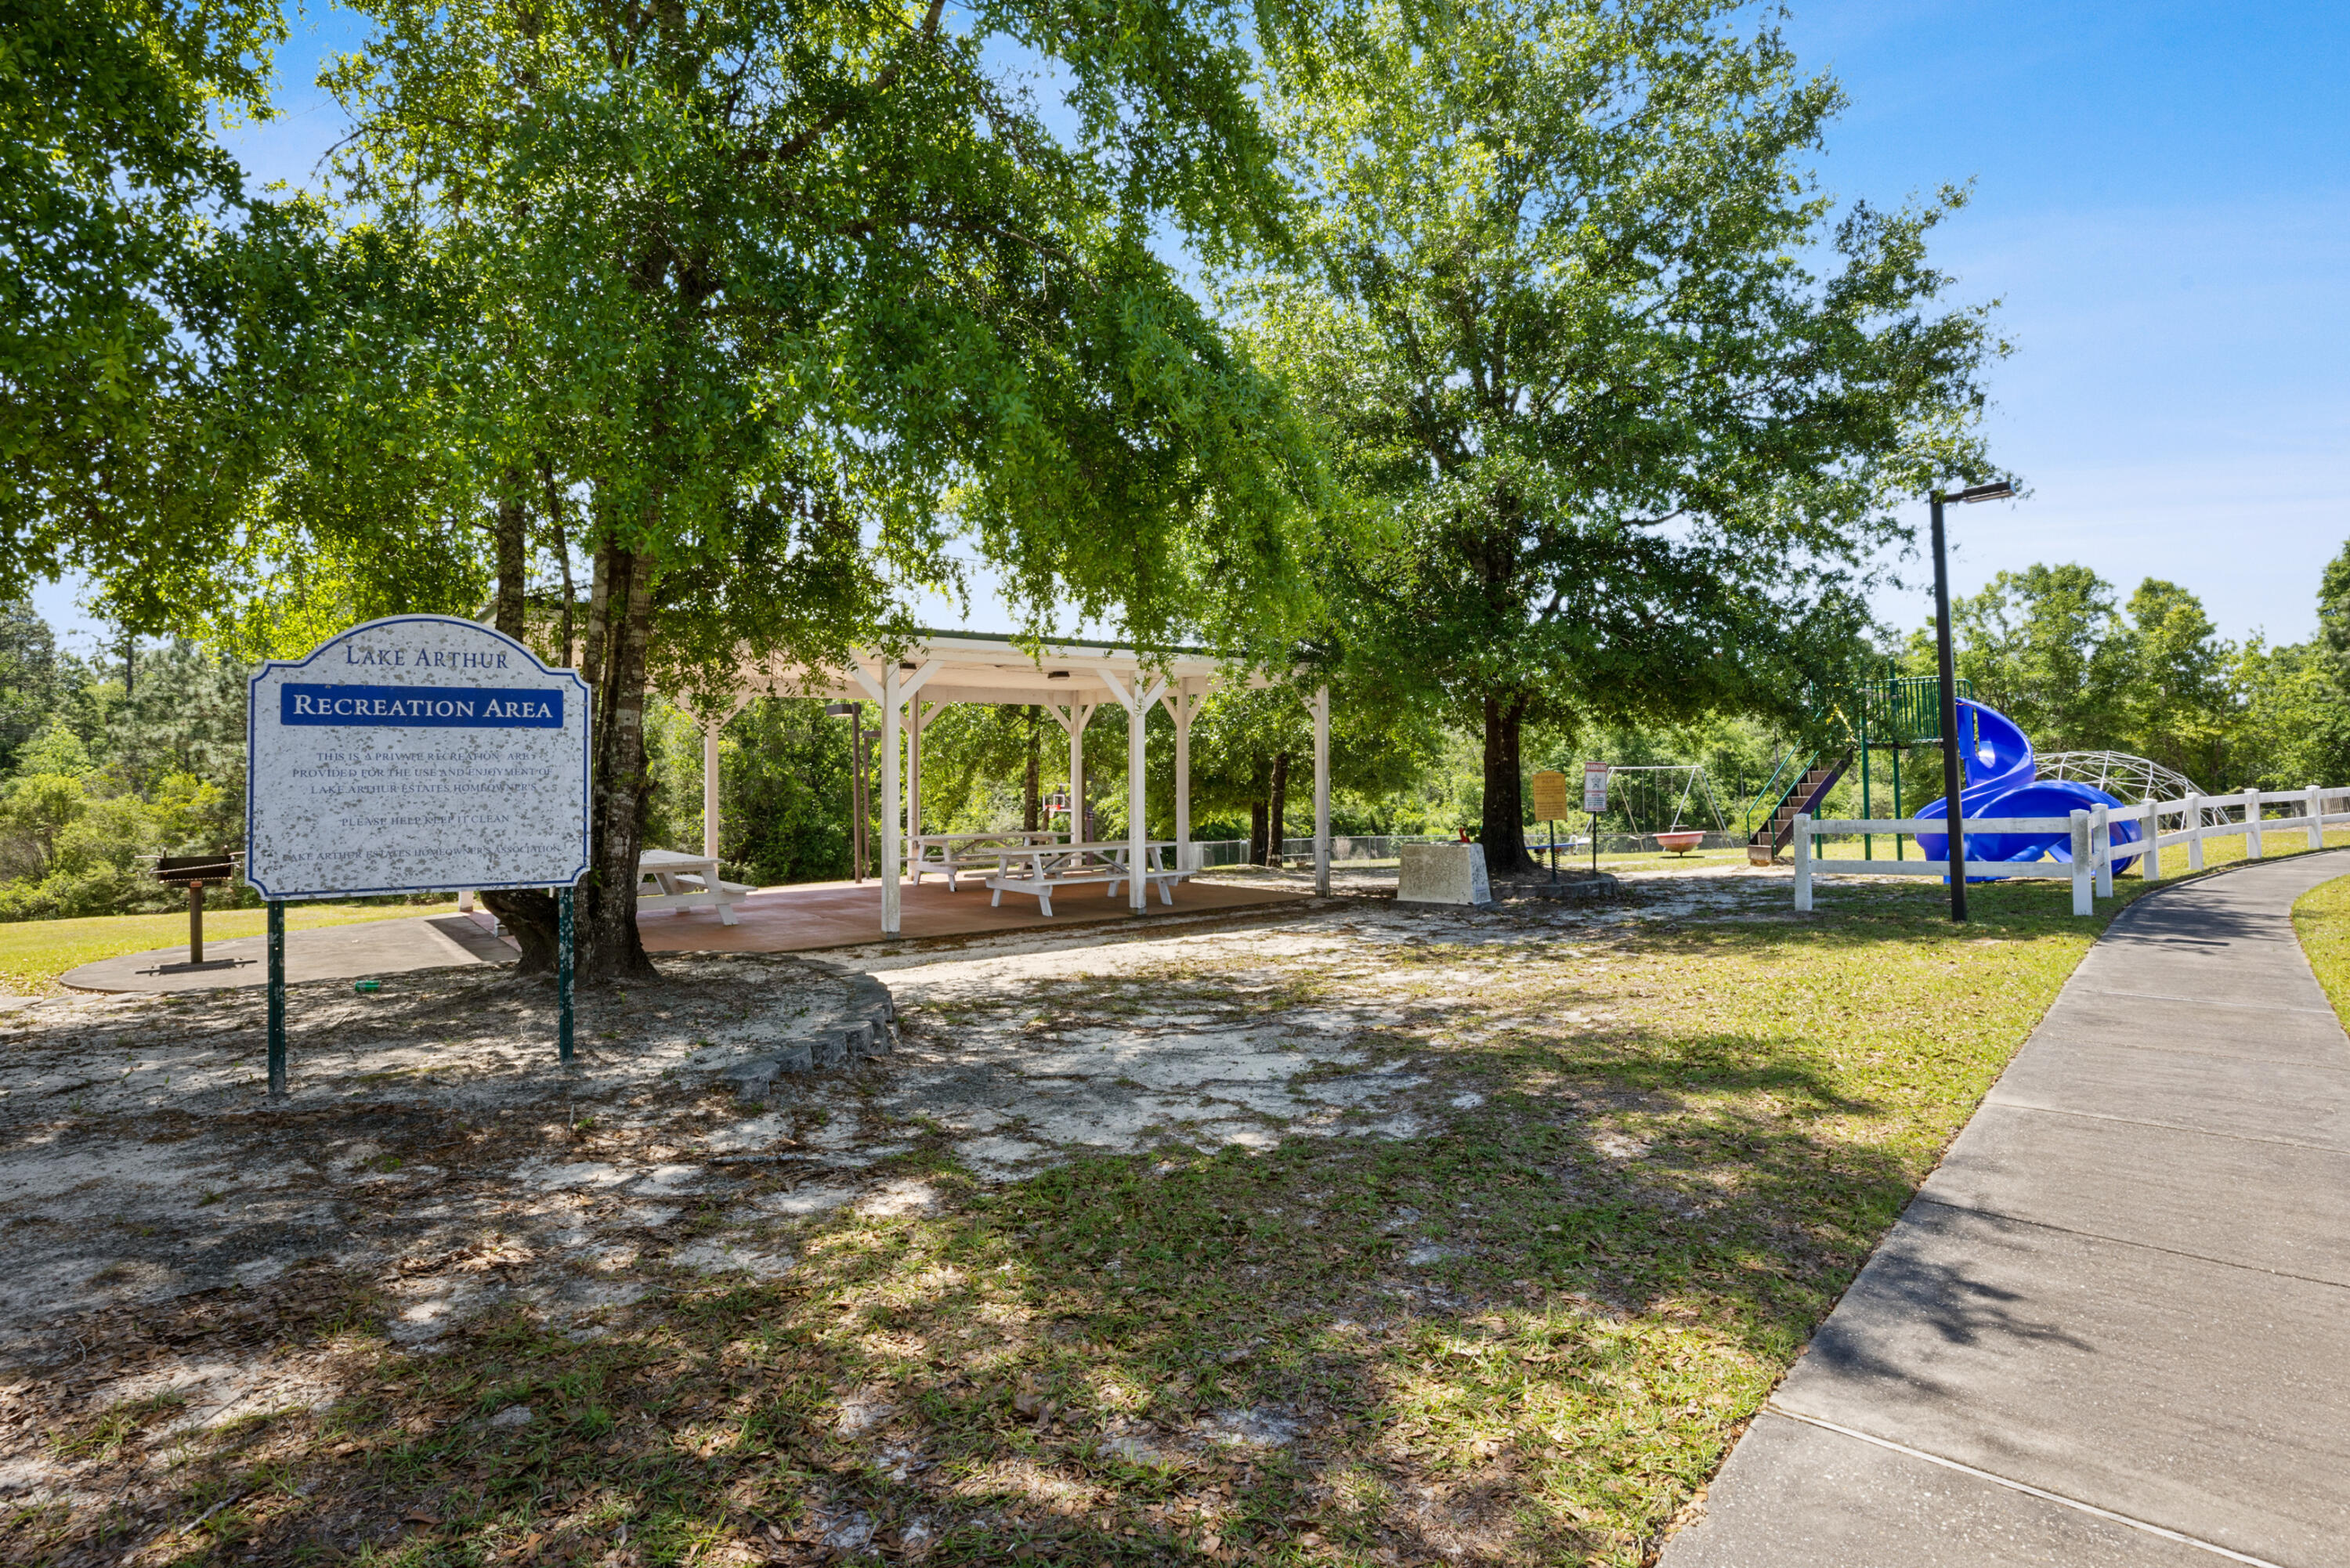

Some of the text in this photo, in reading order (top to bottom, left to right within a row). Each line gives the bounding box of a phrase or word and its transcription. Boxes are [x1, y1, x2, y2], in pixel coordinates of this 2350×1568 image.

[345, 645, 508, 669] LAKE ARTHUR
[293, 694, 553, 718] RECREATION AREA
[316, 752, 345, 761] THIS
[349, 753, 360, 761] IS
[364, 752, 372, 761] A
[375, 752, 424, 761] PRIVATE
[427, 752, 500, 761] RECREATION
[292, 767, 553, 778] PROVIDED FOR THE USE AND ENJOYMENT OF
[311, 786, 344, 794] LAKE
[348, 785, 397, 793] ARTHUR
[401, 784, 450, 793] ESTATES
[342, 817, 387, 826] PLEASE
[392, 816, 421, 826] HELP
[471, 815, 509, 823] CLEAN
[316, 851, 362, 861] ARTHUR
[366, 849, 411, 858] ESTATES
[494, 844, 560, 854] ASSOCIATION
